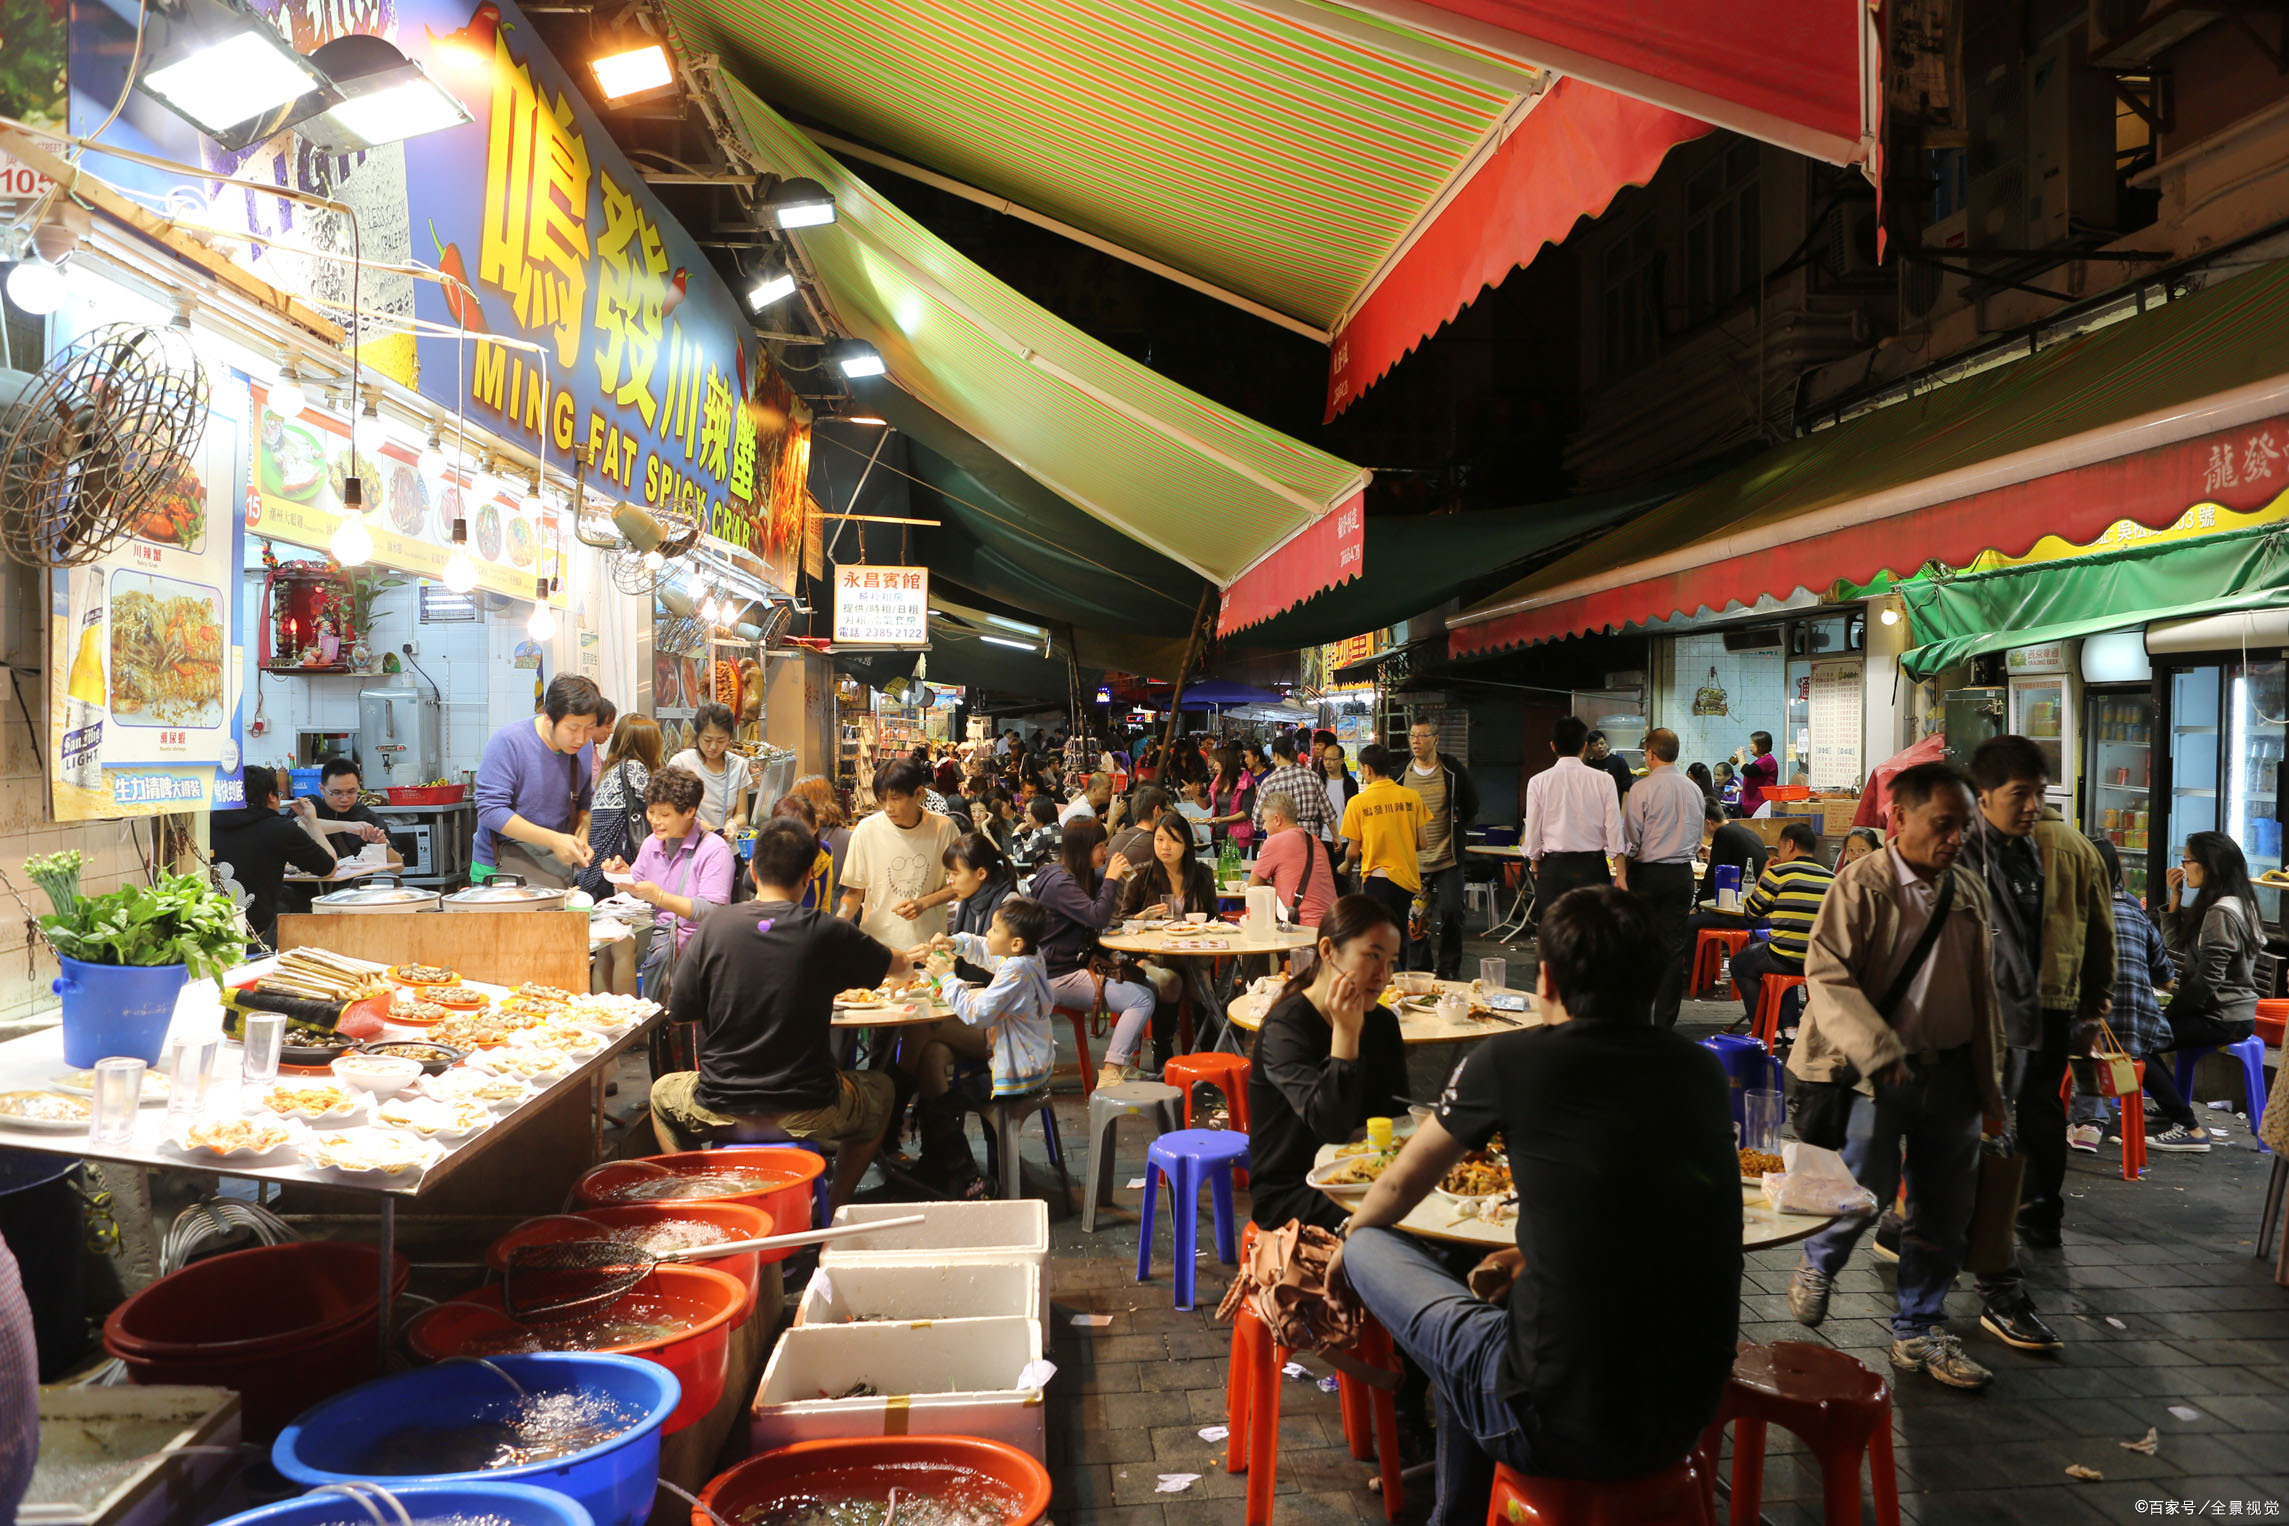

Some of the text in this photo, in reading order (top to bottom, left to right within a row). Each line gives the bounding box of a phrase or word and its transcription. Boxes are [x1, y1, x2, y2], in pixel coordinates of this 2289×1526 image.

[473, 341, 575, 450] MING
[589, 413, 638, 488] FAT
[645, 454, 708, 524] SPICY
[711, 498, 751, 549] CRAB
[2203, 430, 2289, 494] 龍發
[2198, 504, 2216, 528] 號
[133, 543, 162, 562] 川辣蟹
[843, 571, 921, 590] 永昌賓館
[866, 628, 893, 638] 2385
[895, 628, 922, 639] 2122
[65, 749, 99, 771] LIGHT
